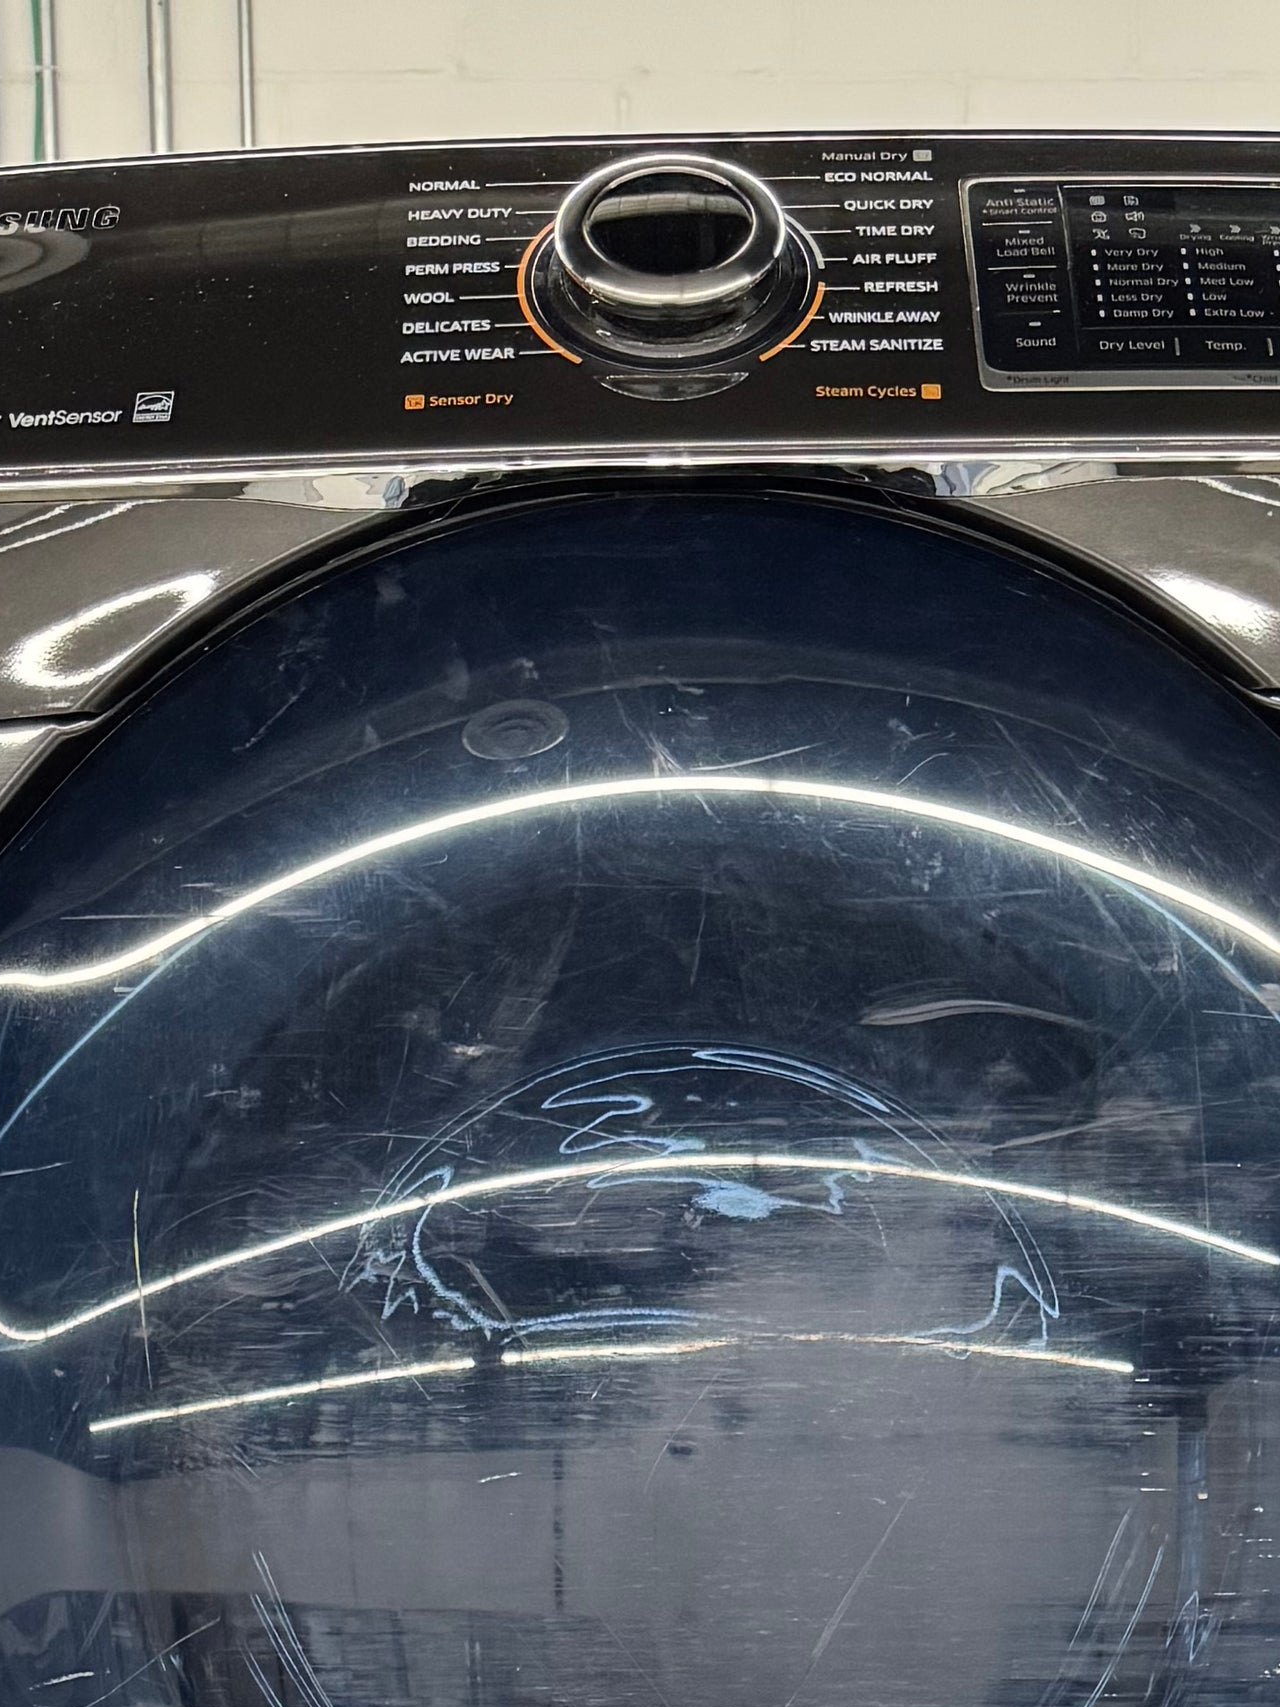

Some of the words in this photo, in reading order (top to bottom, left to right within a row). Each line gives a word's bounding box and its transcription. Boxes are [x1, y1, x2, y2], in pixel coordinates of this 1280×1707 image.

[822, 152, 875, 161] Manual
[879, 152, 907, 162] Dry
[824, 173, 856, 182] ECO
[861, 172, 933, 181] NORMAL
[409, 180, 480, 192] NORMAL
[844, 201, 895, 210] QUICK
[900, 200, 933, 209] DRY
[408, 209, 463, 221] HEAVY
[468, 208, 512, 219] DUTY
[856, 226, 896, 235] TIME
[901, 226, 934, 235] DRY
[407, 235, 481, 247] BEDDING
[853, 255, 881, 264] AIR
[886, 254, 936, 263] FLUFF
[406, 264, 448, 276] PERM
[453, 262, 500, 273] PRESS
[865, 282, 938, 292] REFRESH
[404, 292, 454, 304] WOOL
[829, 312, 893, 323] WRINKLE
[896, 312, 940, 322] AWAY
[402, 320, 490, 334] DELICATES
[811, 340, 865, 351] STEAM
[870, 339, 943, 350] SANITIZE
[1016, 338, 1056, 347] Sound
[1100, 341, 1124, 351] Dry
[1129, 341, 1164, 350] Level
[401, 350, 460, 363] ACTIVE
[465, 348, 514, 360] WEAR
[816, 386, 863, 396] Steam
[867, 386, 916, 396] Cycles
[430, 394, 481, 407] Sensor
[486, 393, 513, 406] Dry
[9, 407, 122, 429] VentSensor
